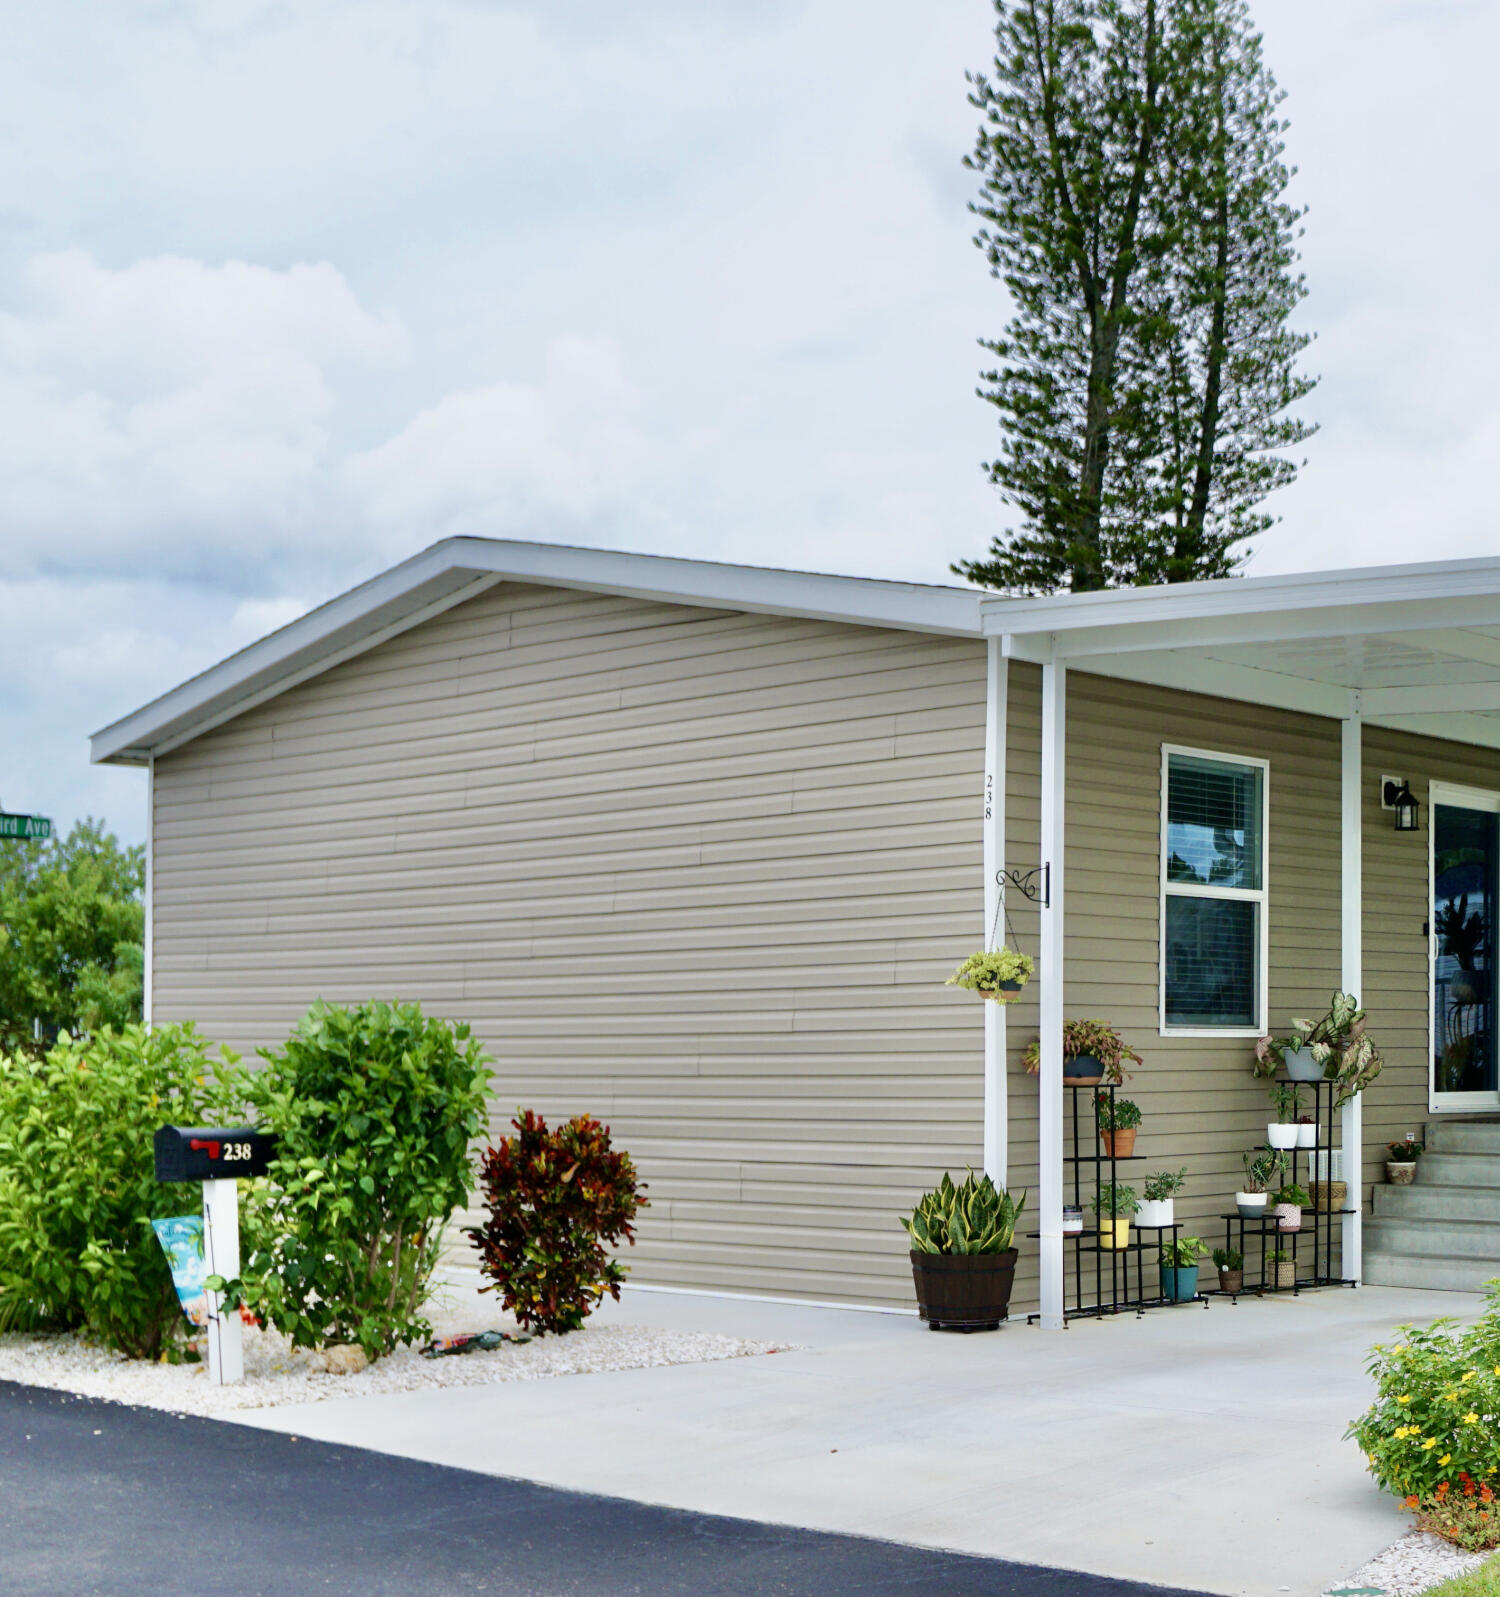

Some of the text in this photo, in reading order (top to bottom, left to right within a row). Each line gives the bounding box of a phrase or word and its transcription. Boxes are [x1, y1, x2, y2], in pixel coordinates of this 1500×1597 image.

[985, 774, 993, 820] 238
[24, 817, 49, 836] Ave
[223, 1142, 252, 1161] 238
